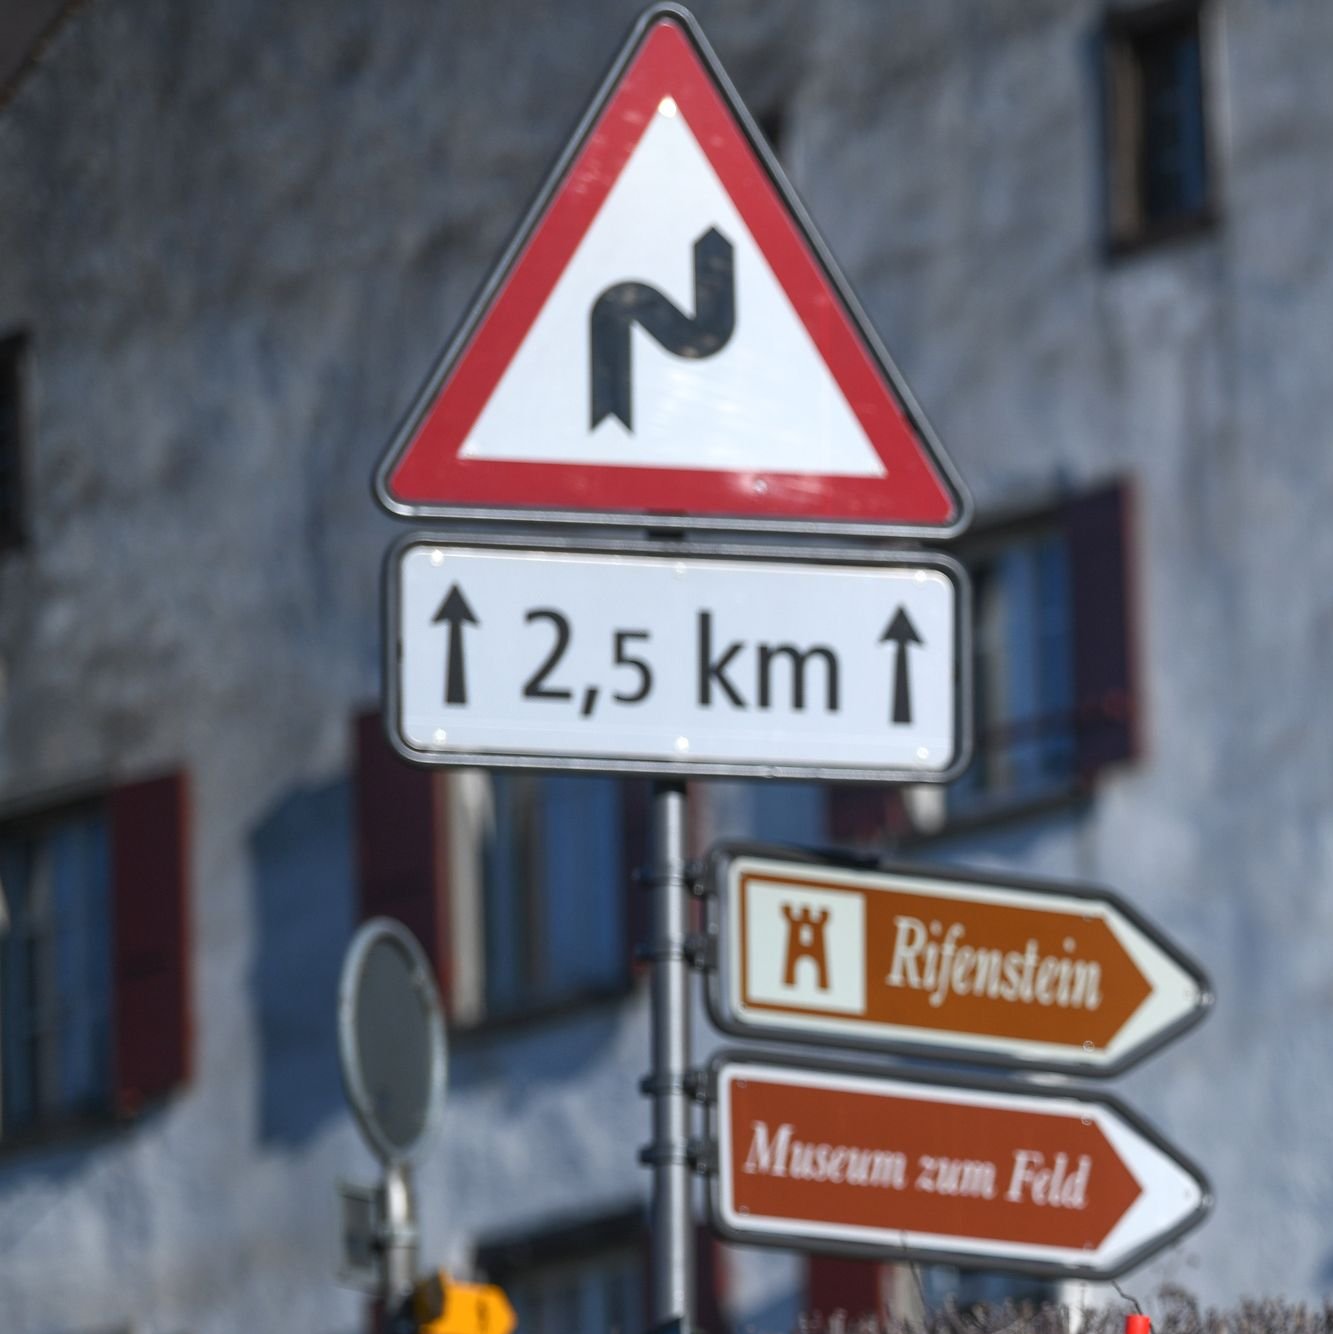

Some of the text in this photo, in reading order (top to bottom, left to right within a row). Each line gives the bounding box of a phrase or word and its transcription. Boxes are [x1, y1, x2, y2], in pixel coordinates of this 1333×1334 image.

[521, 609, 839, 717] 2,5 km
[887, 916, 1102, 1010] Rifenstein
[743, 1121, 1091, 1208] Museum zum Feld
